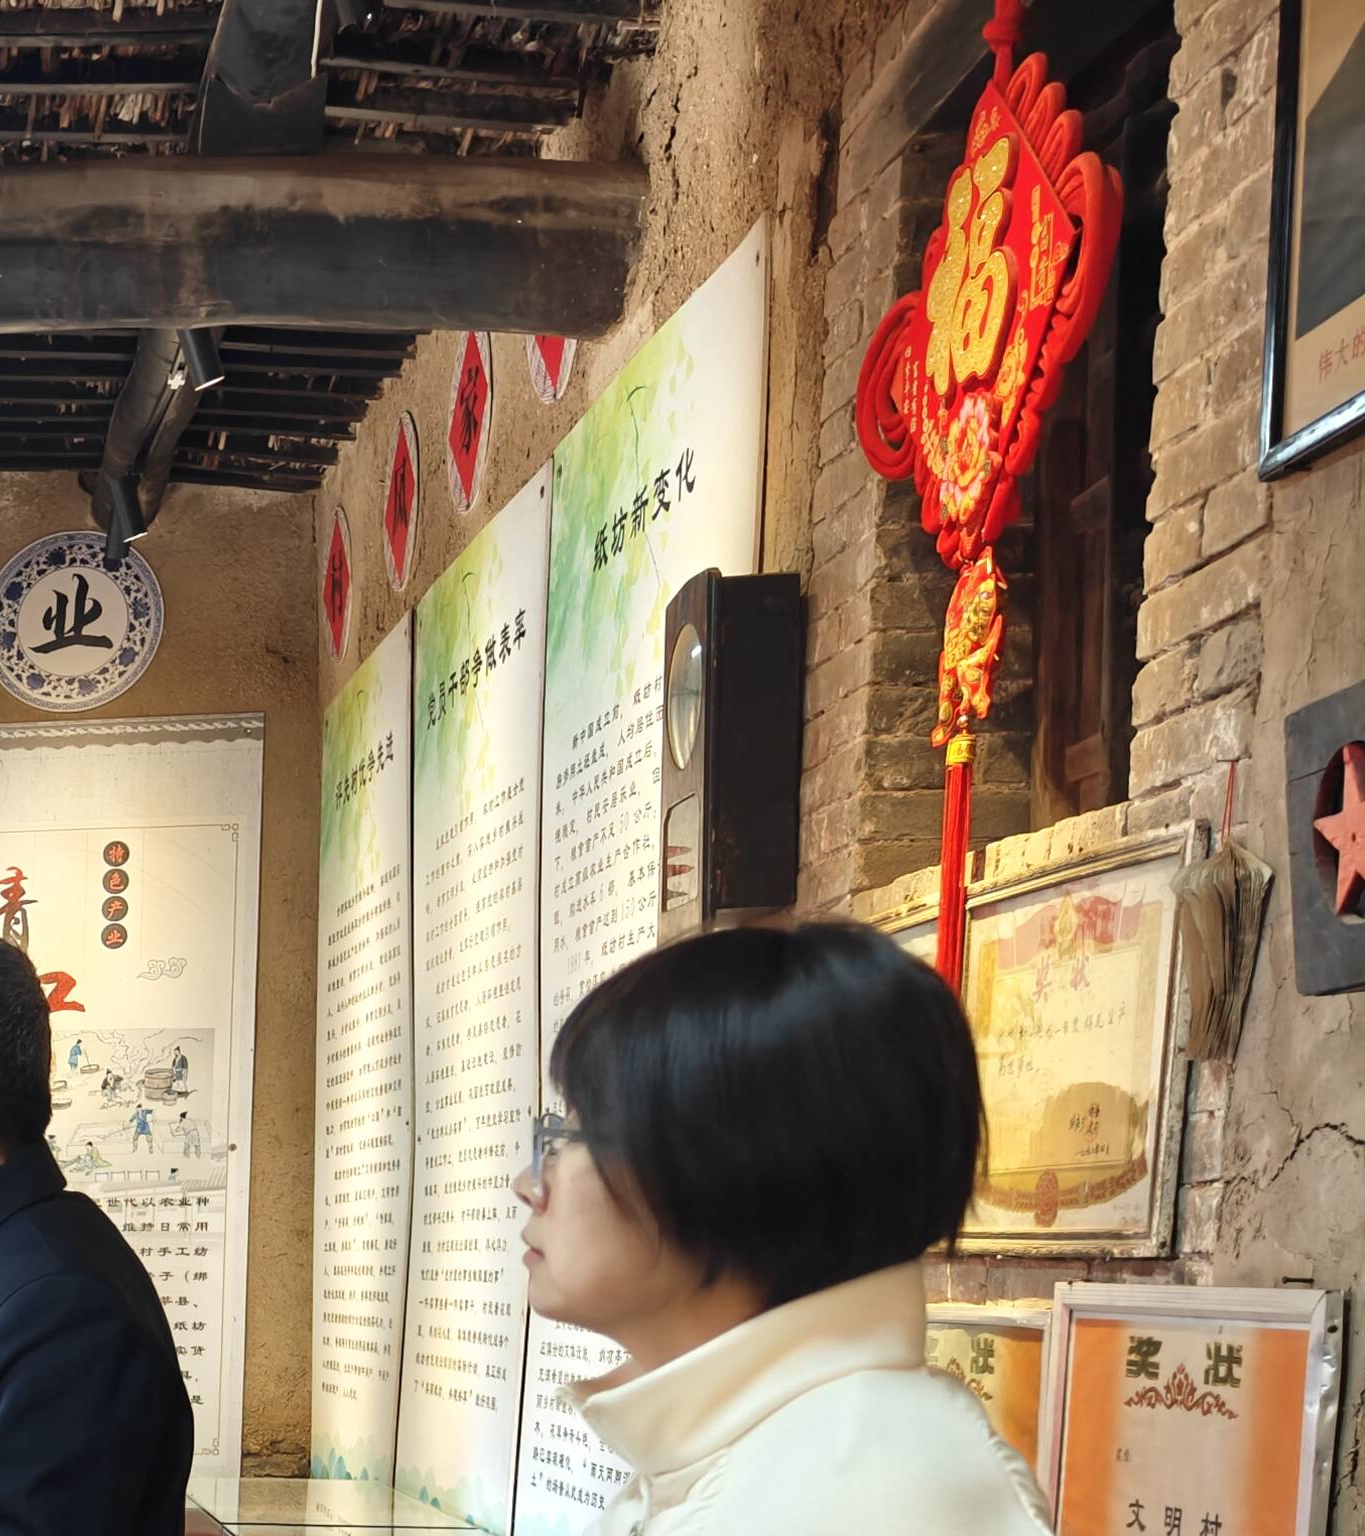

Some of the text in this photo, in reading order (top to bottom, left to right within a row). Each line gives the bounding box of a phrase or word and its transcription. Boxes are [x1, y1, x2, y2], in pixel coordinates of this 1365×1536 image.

[926, 136, 1009, 395] 福
[592, 447, 696, 573] 纸坊新变化
[426, 607, 527, 730] 党员干部争做表率
[105, 845, 125, 945] 特色产业
[1125, 1335, 1243, 1388] 奖状
